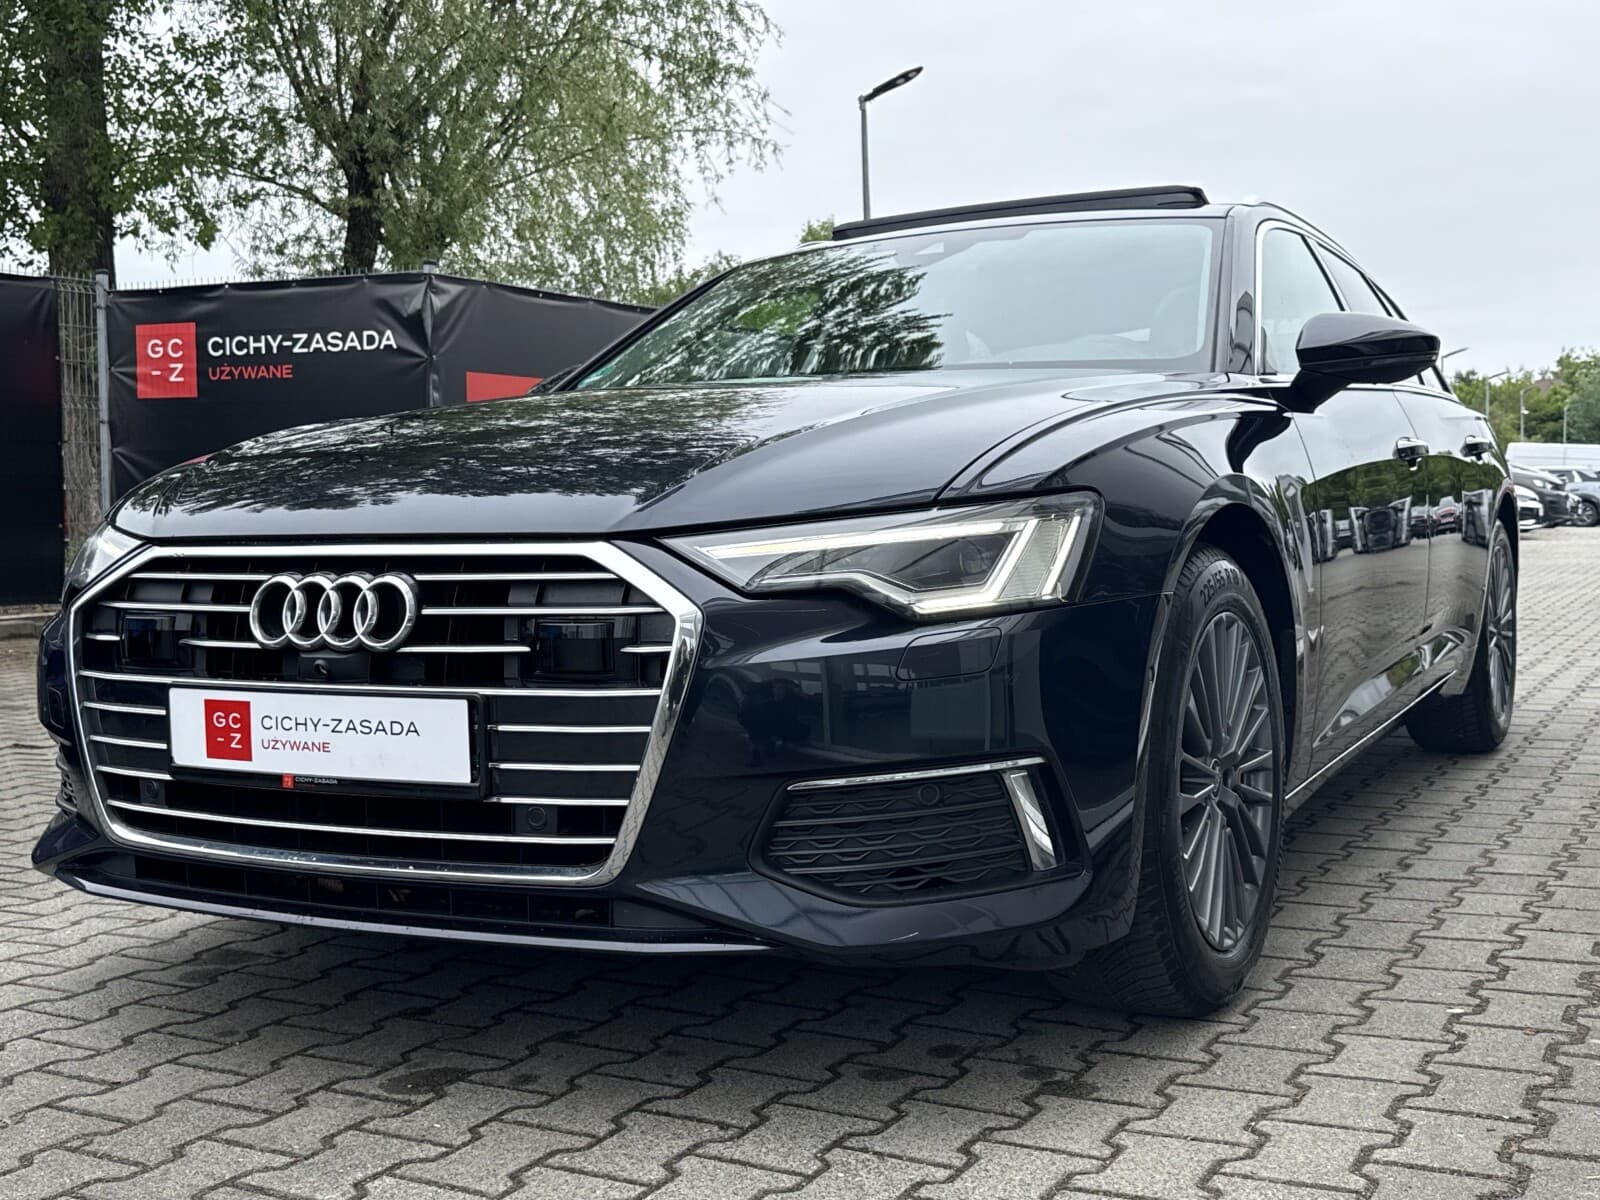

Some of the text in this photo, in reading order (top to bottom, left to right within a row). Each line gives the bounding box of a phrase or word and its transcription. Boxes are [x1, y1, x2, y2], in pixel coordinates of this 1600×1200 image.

[147, 338, 183, 358] GC
[207, 329, 397, 357] CICHY-ZASADA
[208, 363, 293, 380] UŻYWANE
[212, 711, 241, 729] GC
[261, 715, 420, 736] CICHY-ZASADA
[261, 737, 331, 753] UŻYWANE
